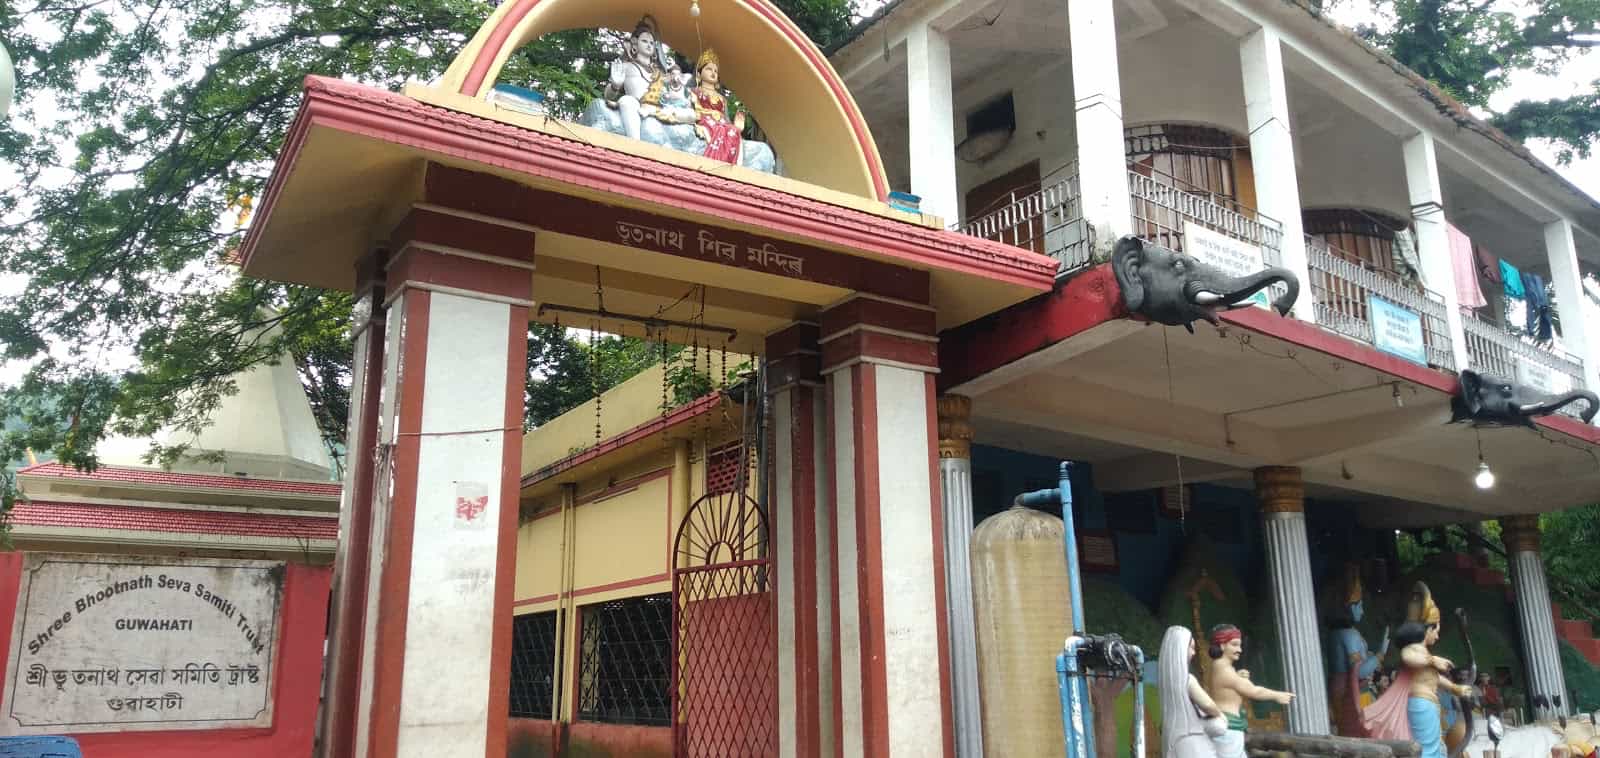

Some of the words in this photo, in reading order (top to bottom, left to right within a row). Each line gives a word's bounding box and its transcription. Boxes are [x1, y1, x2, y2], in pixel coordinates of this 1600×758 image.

[616, 220, 685, 249] ভূতনাথ
[28, 611, 72, 655] Shree
[75, 575, 153, 614] Bhootnath
[158, 574, 191, 592] Seva
[195, 583, 236, 619] Samiti
[237, 613, 264, 656] Trust
[115, 619, 193, 631] GUWAHATI
[171, 662, 222, 685] সমিতি
